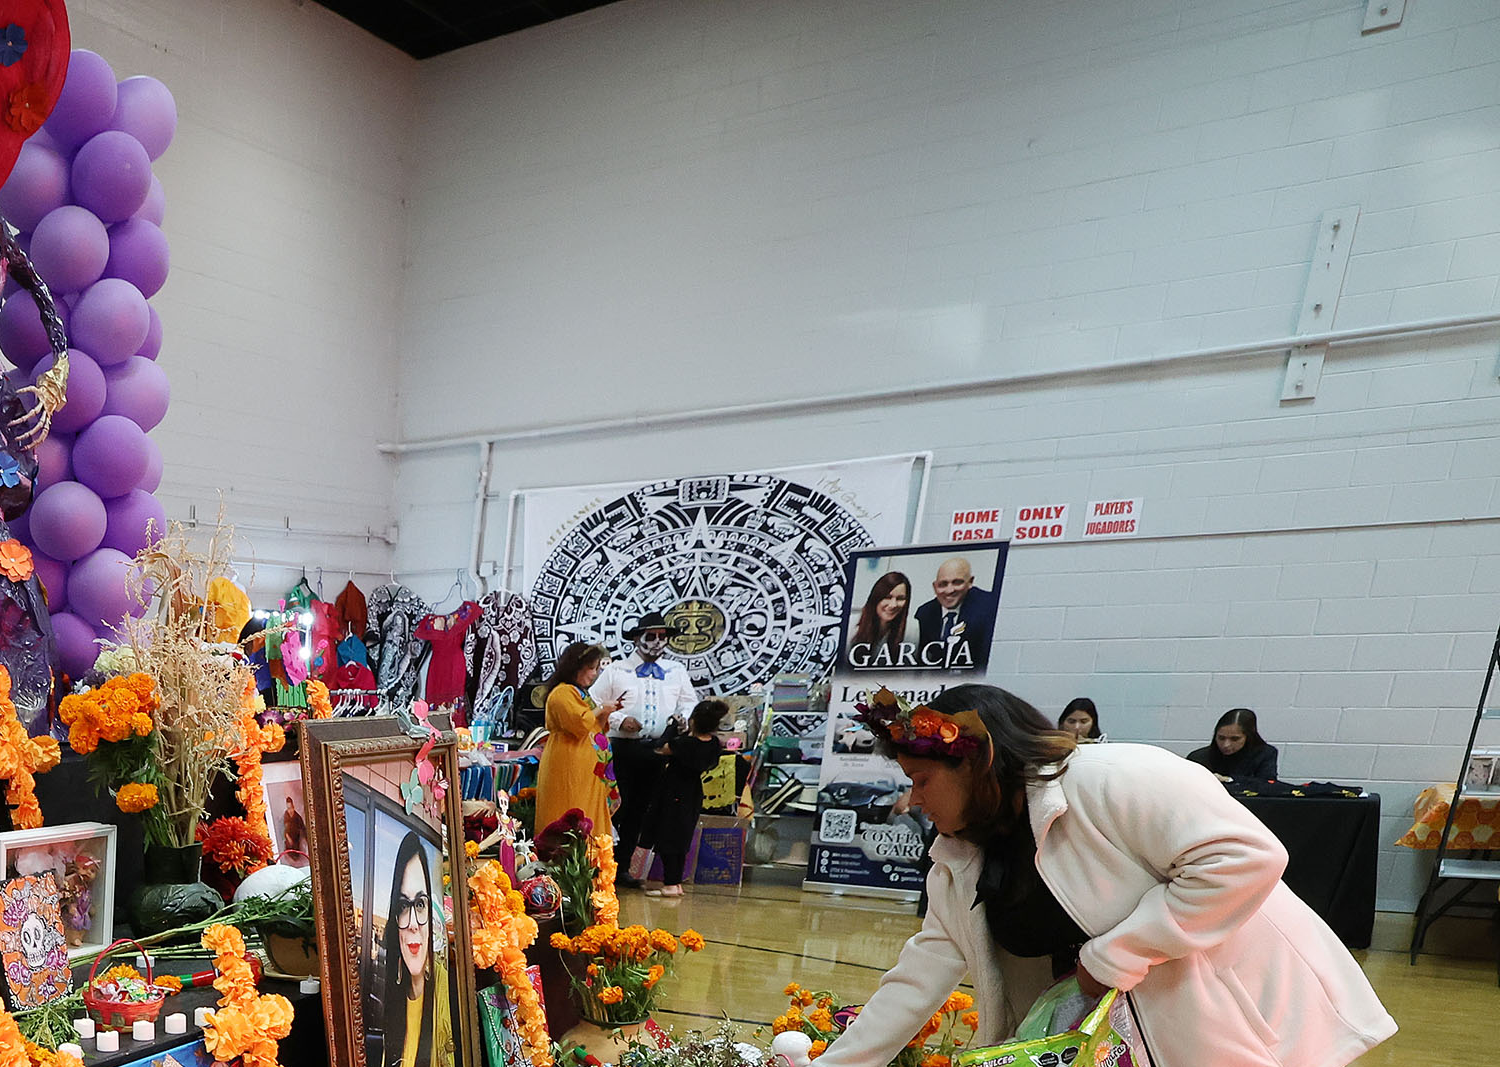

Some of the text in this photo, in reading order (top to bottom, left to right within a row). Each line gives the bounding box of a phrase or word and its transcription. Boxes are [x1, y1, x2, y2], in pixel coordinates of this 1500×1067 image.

[1019, 505, 1066, 522] ONLY
[1093, 500, 1134, 516] PLAYER'S
[953, 509, 1000, 525] HOME
[952, 528, 994, 541] CASA
[1015, 524, 1063, 540] SOLO
[1085, 519, 1137, 536] JUGADORES
